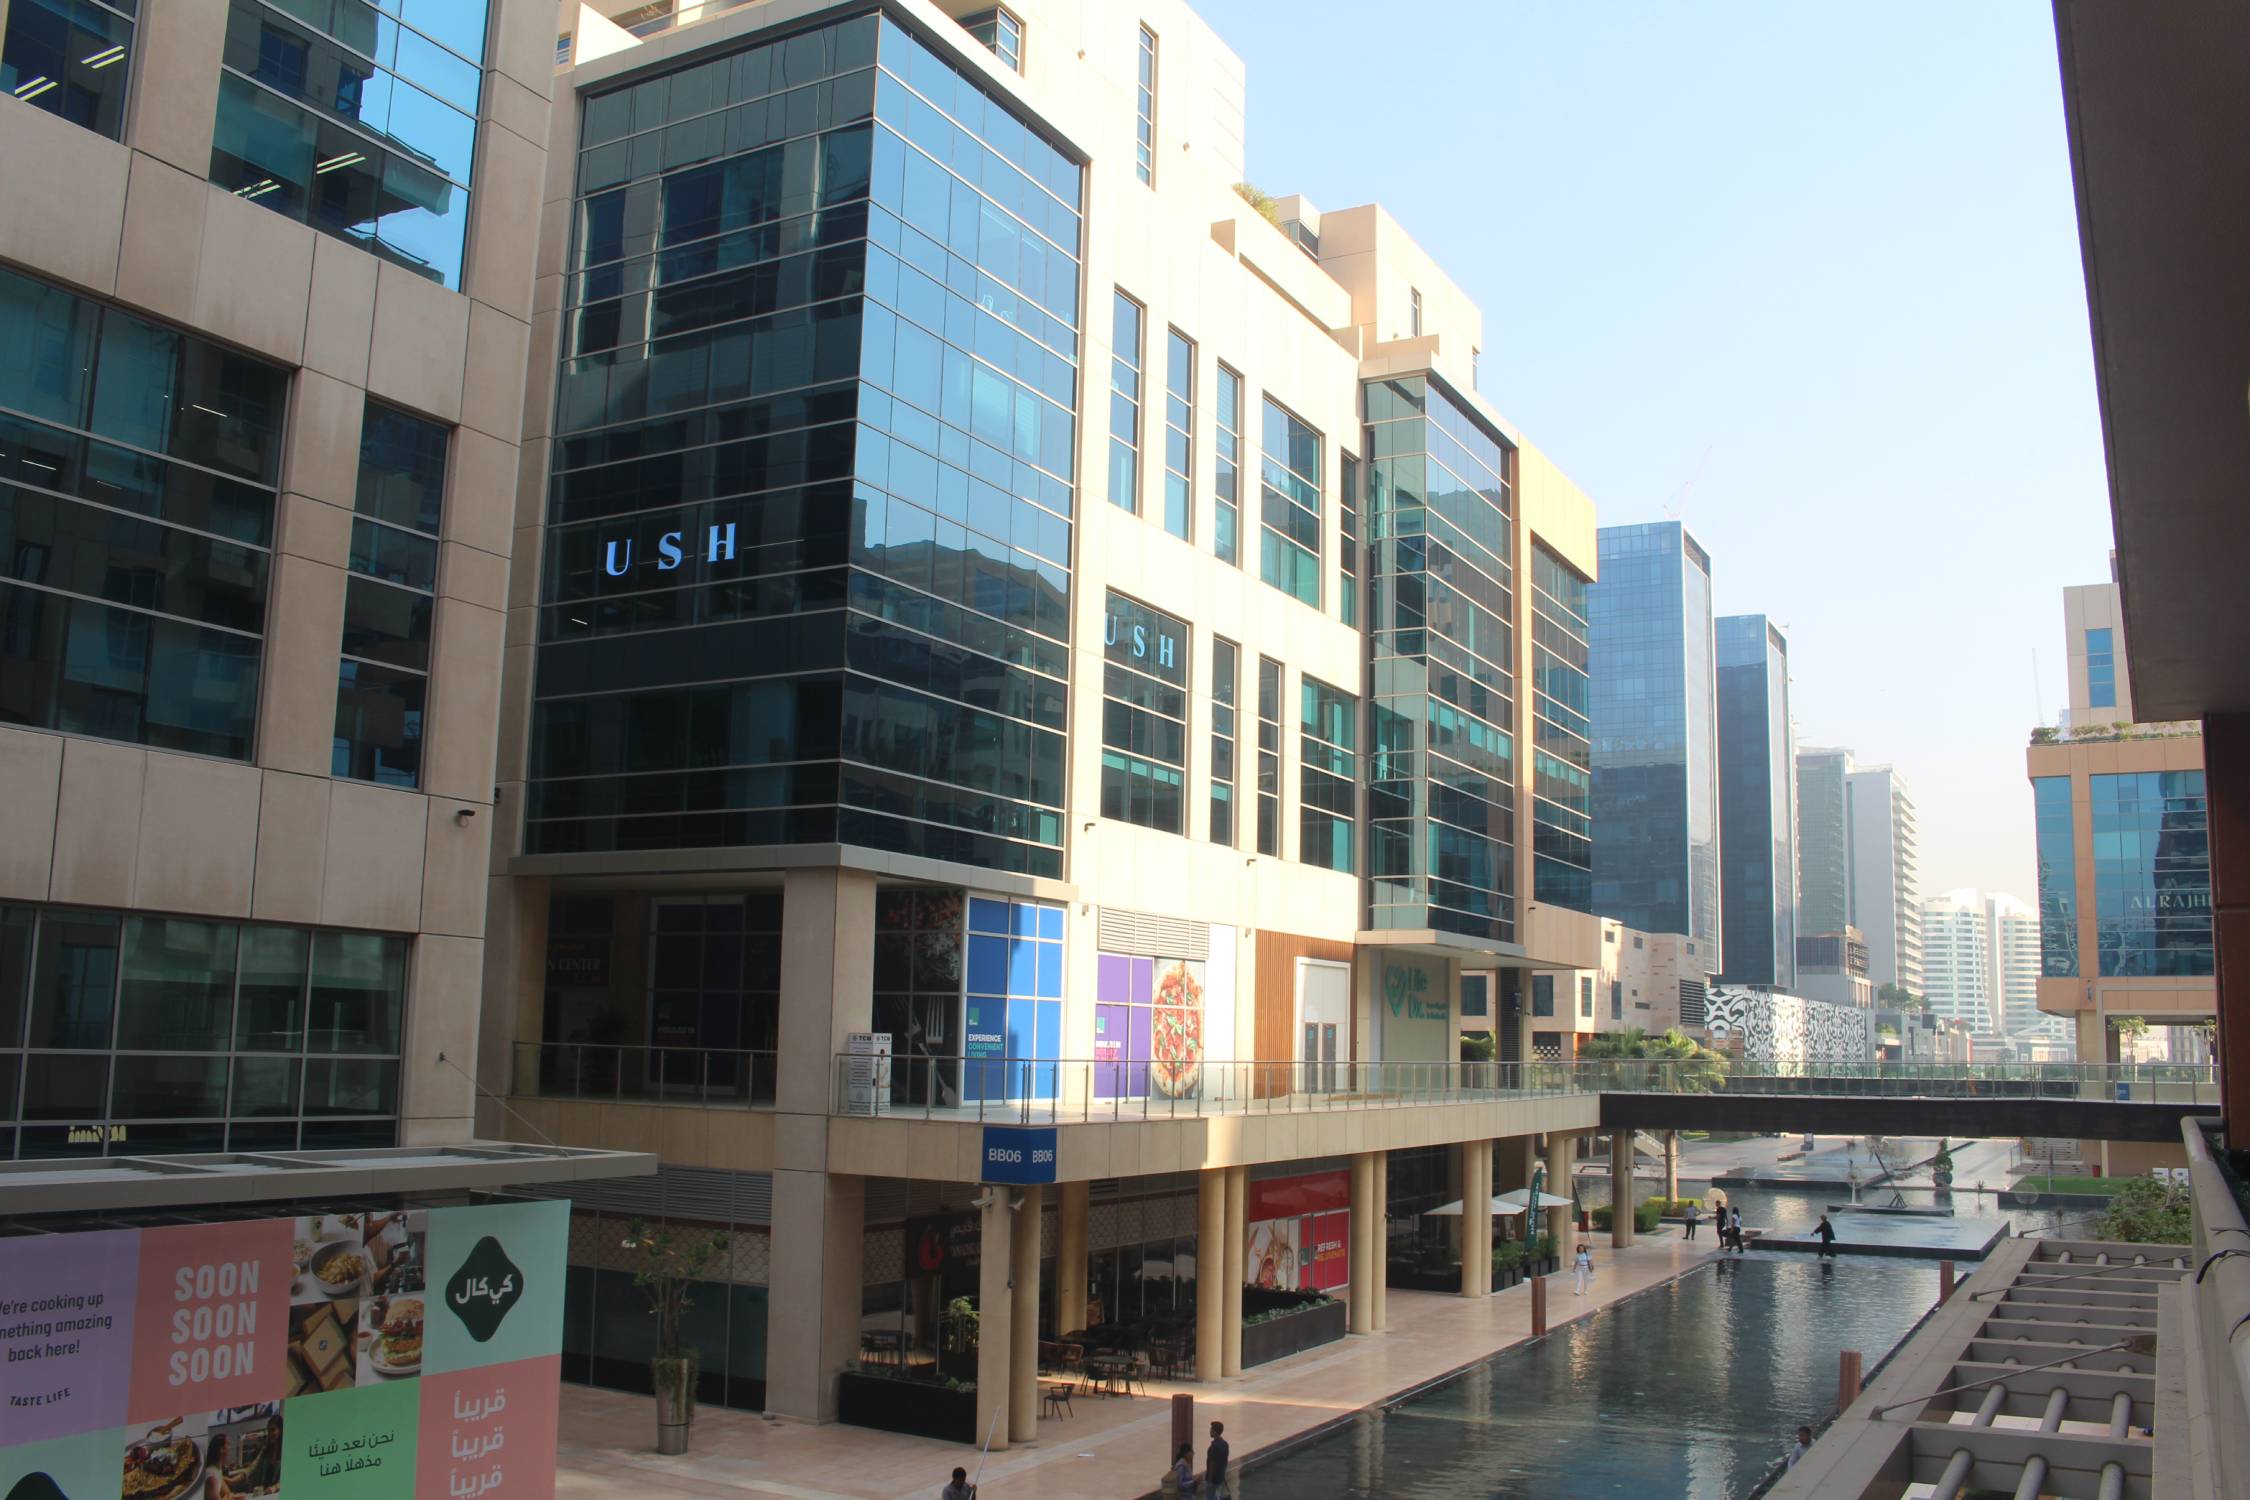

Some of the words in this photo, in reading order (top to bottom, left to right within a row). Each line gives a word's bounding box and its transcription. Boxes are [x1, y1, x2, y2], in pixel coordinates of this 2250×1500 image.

[968, 1033, 1001, 1042] EXPERIENCE
[989, 1148, 1022, 1163] BB06
[1032, 1150, 1053, 1164] BB06
[175, 1260, 259, 1302] SOON
[31, 1294, 84, 1311] cooking
[87, 1293, 104, 1308] up
[55, 1314, 112, 1333] amazing
[170, 1301, 257, 1344] SOON
[8, 1344, 42, 1362] back
[45, 1339, 80, 1358] here!
[168, 1341, 254, 1386] SOON
[10, 1395, 42, 1407] TASTE
[46, 1387, 71, 1404] LIFE
[368, 1429, 394, 1448] نحن
[320, 1462, 341, 1477] هنا
